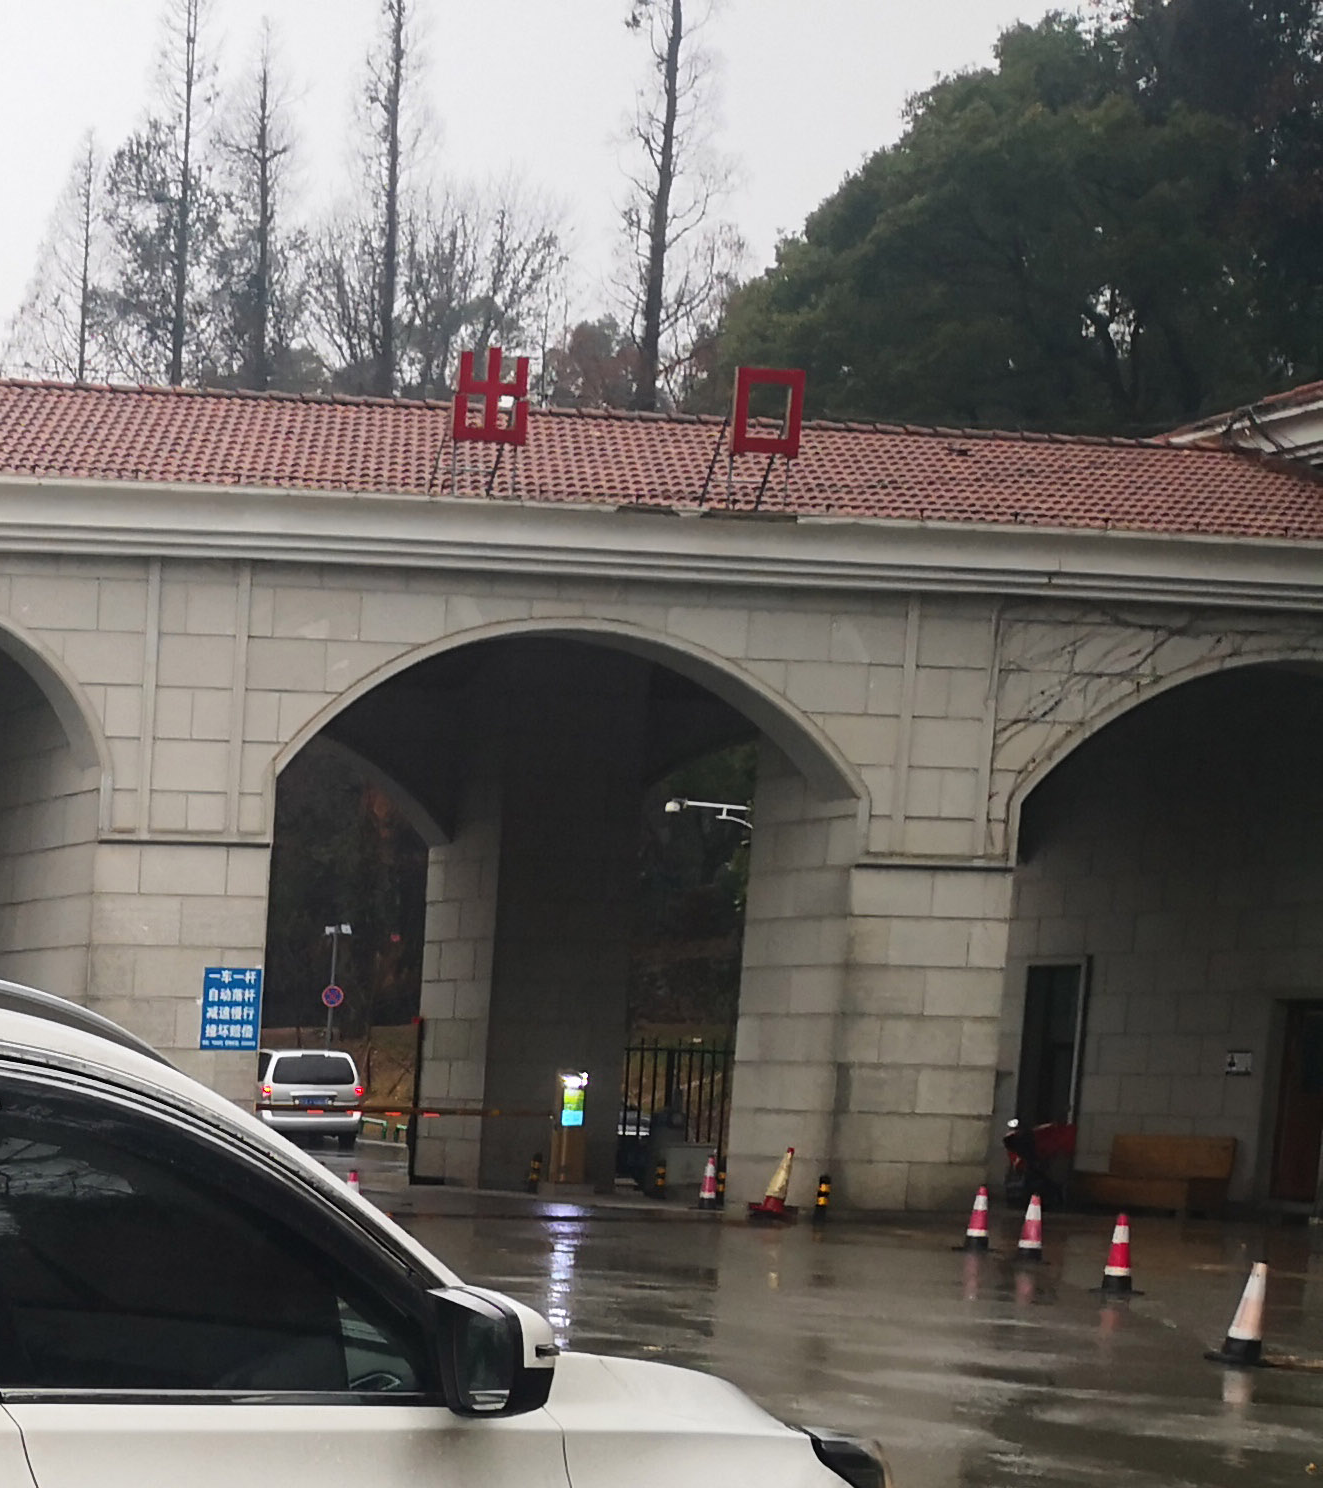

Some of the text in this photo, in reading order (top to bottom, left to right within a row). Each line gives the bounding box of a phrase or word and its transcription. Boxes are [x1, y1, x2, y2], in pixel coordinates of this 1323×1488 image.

[453, 347, 806, 460] 出口
[208, 970, 257, 984] 一车一杆
[206, 1006, 255, 1020] 减速慢行
